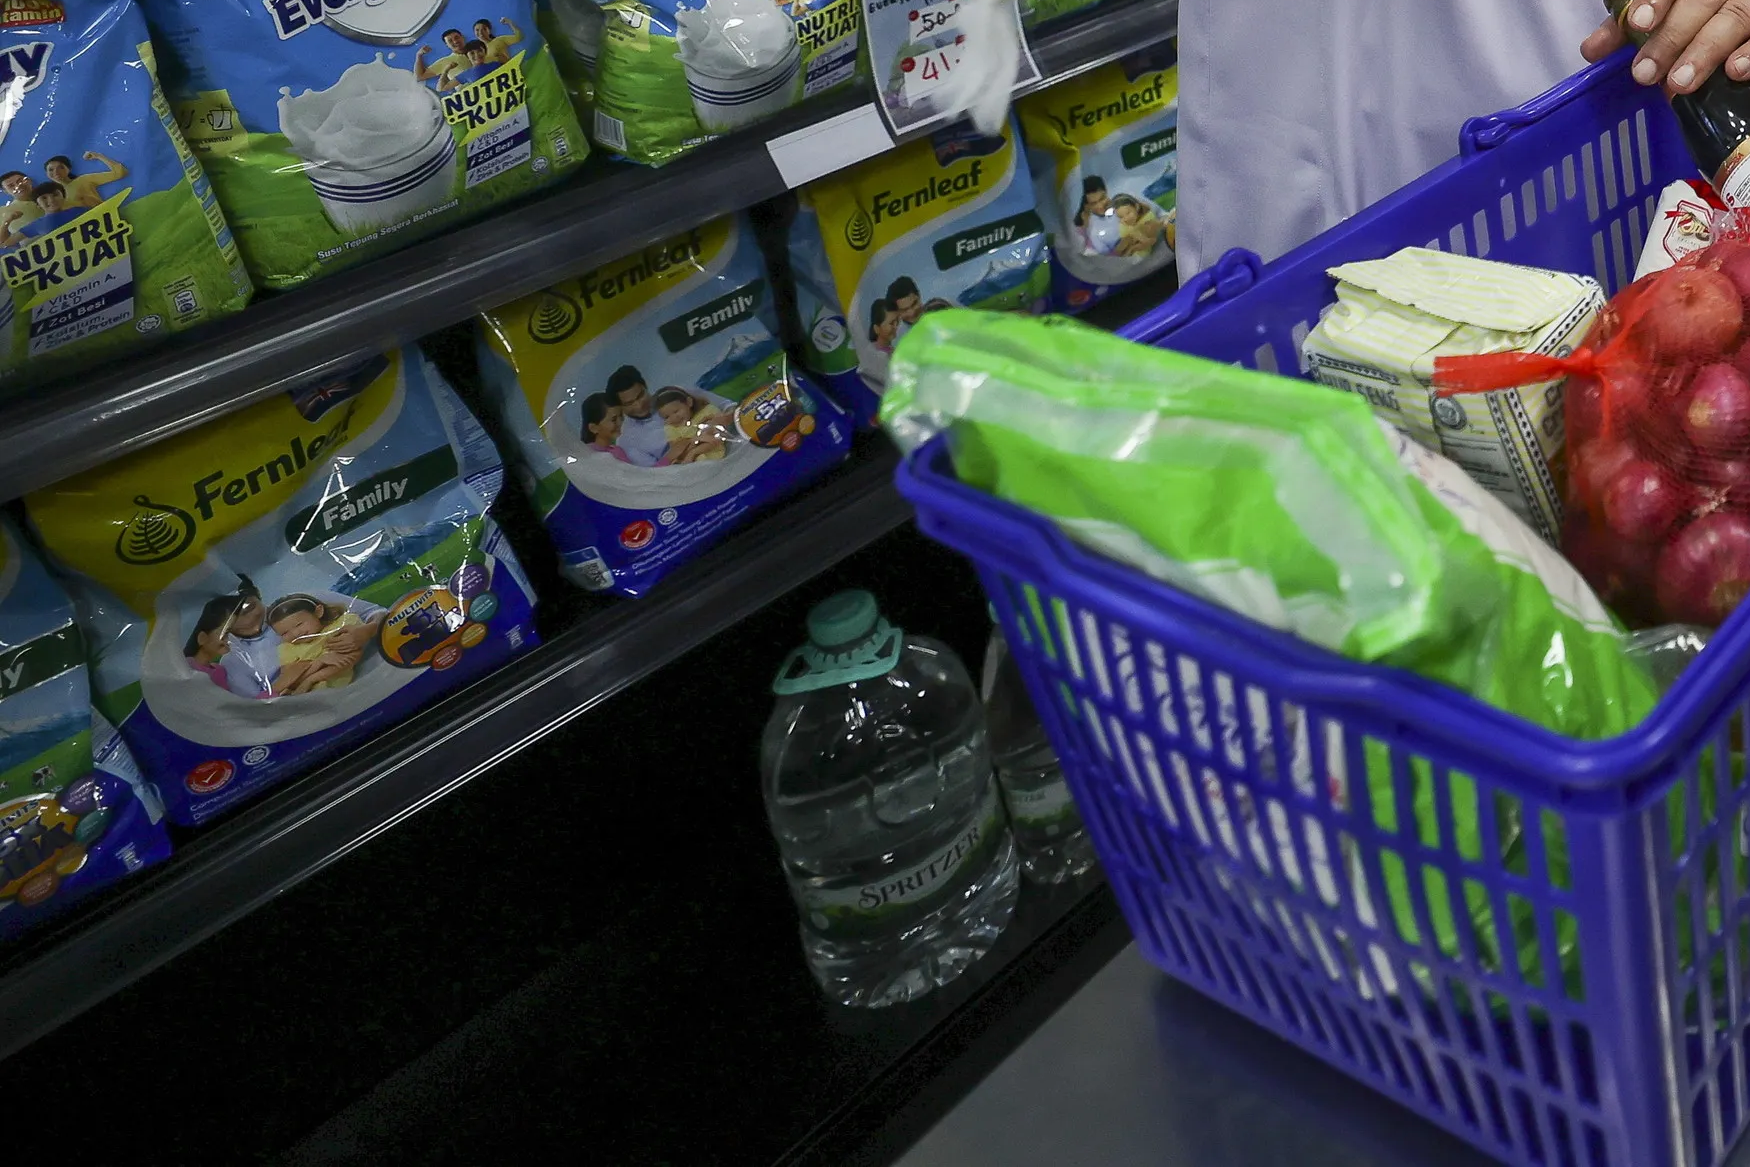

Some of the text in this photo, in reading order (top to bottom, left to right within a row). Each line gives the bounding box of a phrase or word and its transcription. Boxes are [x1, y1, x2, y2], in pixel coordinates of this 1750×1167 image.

[1067, 74, 1165, 130] Fernleaf
[871, 159, 983, 224] Fernleaf
[317, 198, 460, 260] Susu Tepung Segera Berkhasiat
[956, 224, 1016, 256] Family
[578, 230, 704, 309] Fernleaf
[49, 298, 106, 328] Zat Besi
[50, 282, 102, 307] Vitamin
[687, 294, 754, 336] Family
[88, 310, 131, 334] Protein
[193, 398, 358, 522] Fernleaf
[322, 477, 409, 531] Family
[388, 588, 435, 627] MULTIVITS
